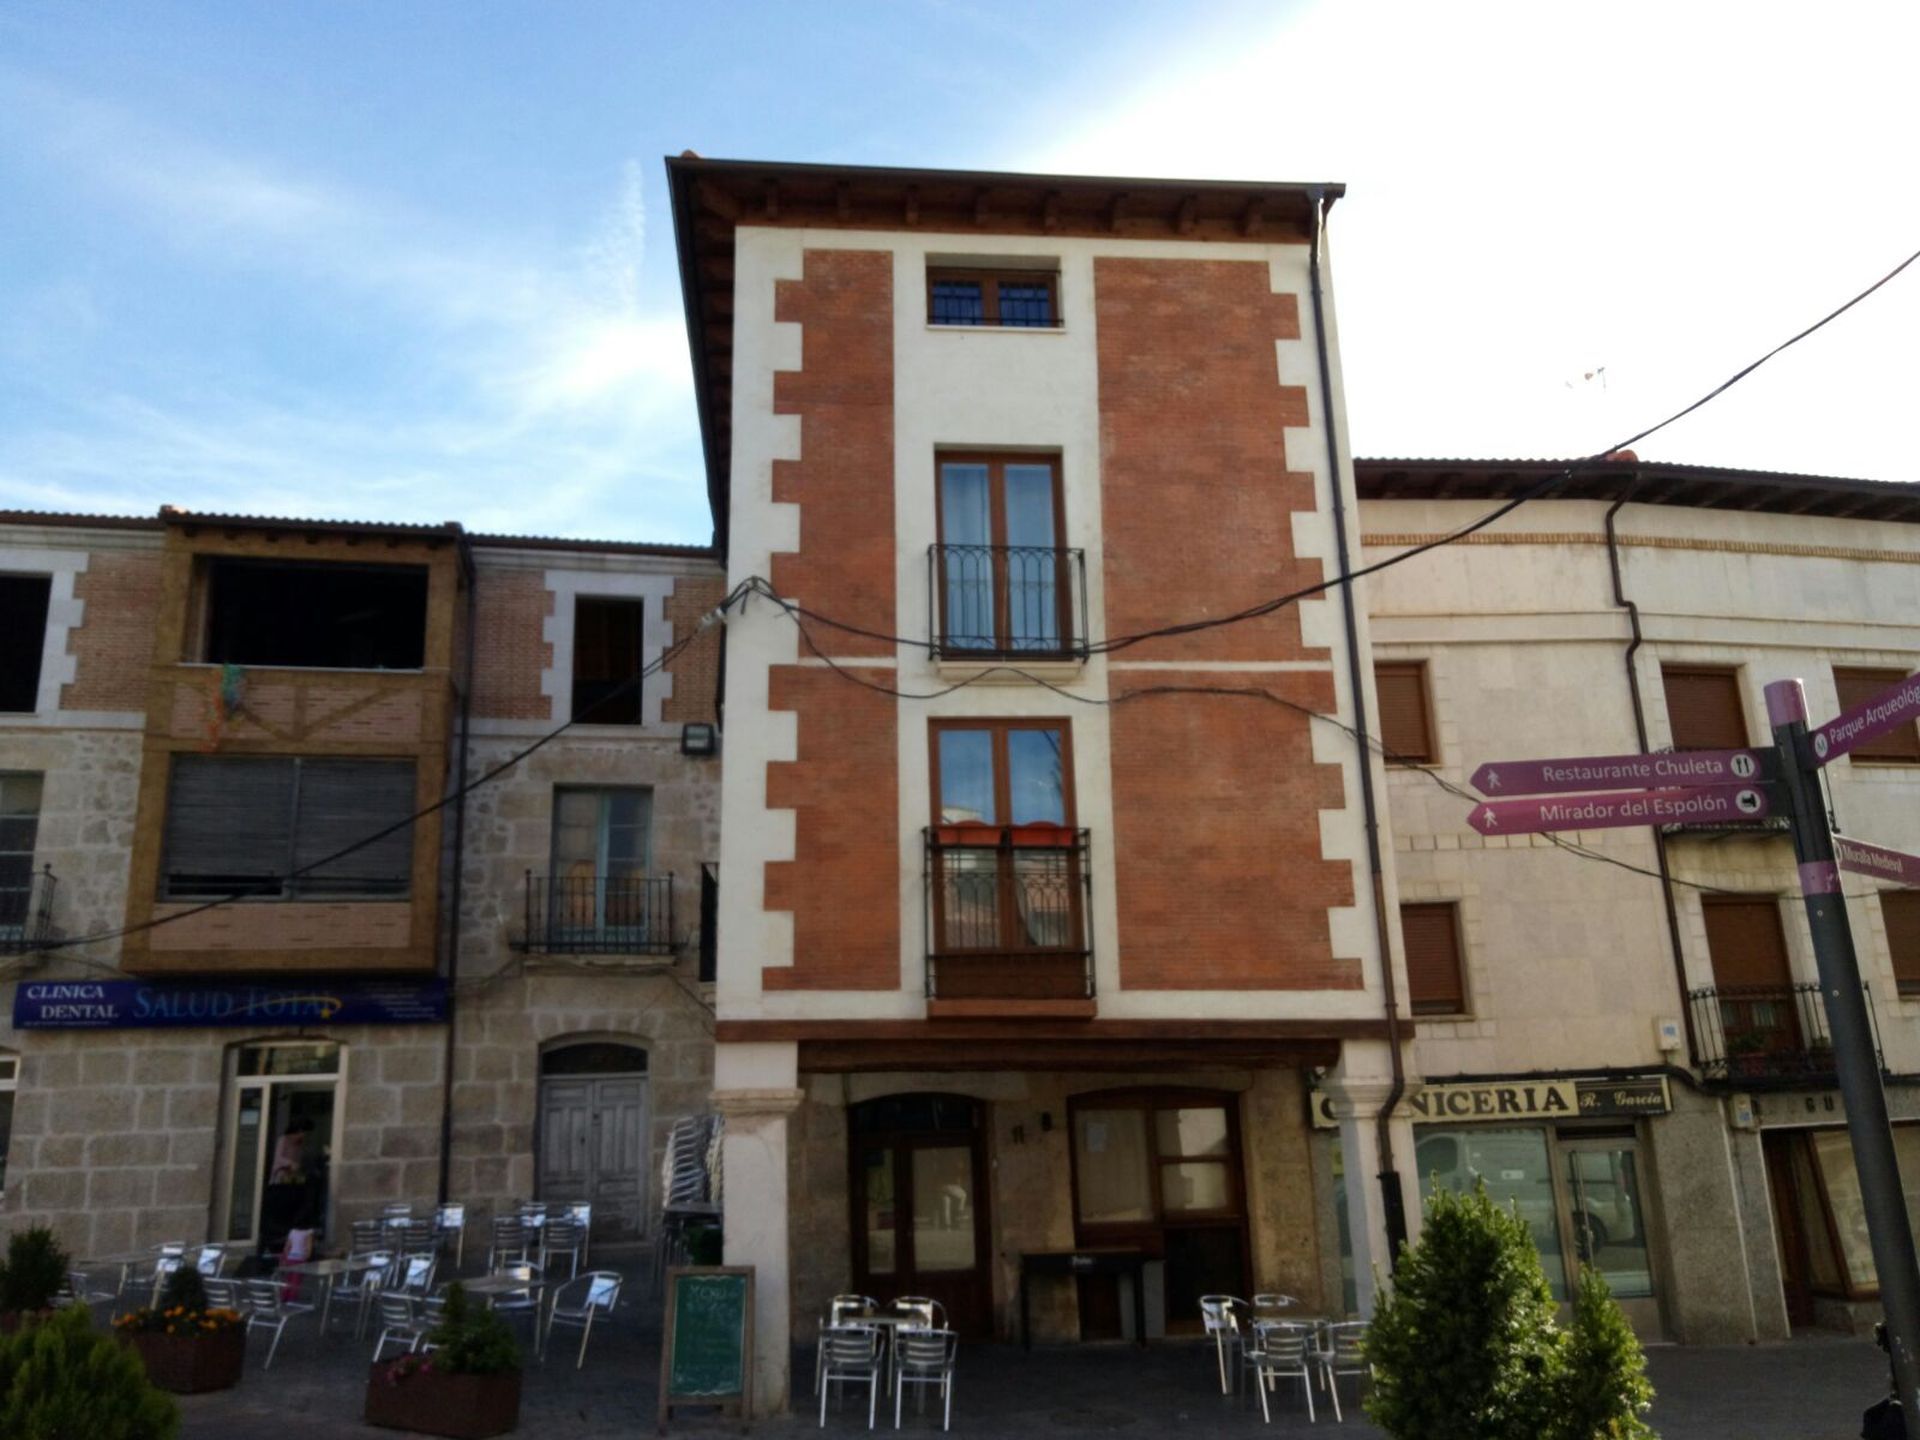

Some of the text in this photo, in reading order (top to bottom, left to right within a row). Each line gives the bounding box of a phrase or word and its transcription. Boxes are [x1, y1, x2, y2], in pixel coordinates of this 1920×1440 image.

[1829, 716, 1865, 744] Parque
[1543, 759, 1723, 782] Restaurante Chuleta
[1540, 795, 1727, 822] Mirador del Espolón
[27, 984, 104, 1000] CLINICA
[132, 987, 232, 1018] SALUD
[40, 1003, 120, 1019] DENTAL
[1320, 1084, 1570, 1119] CNICERIA
